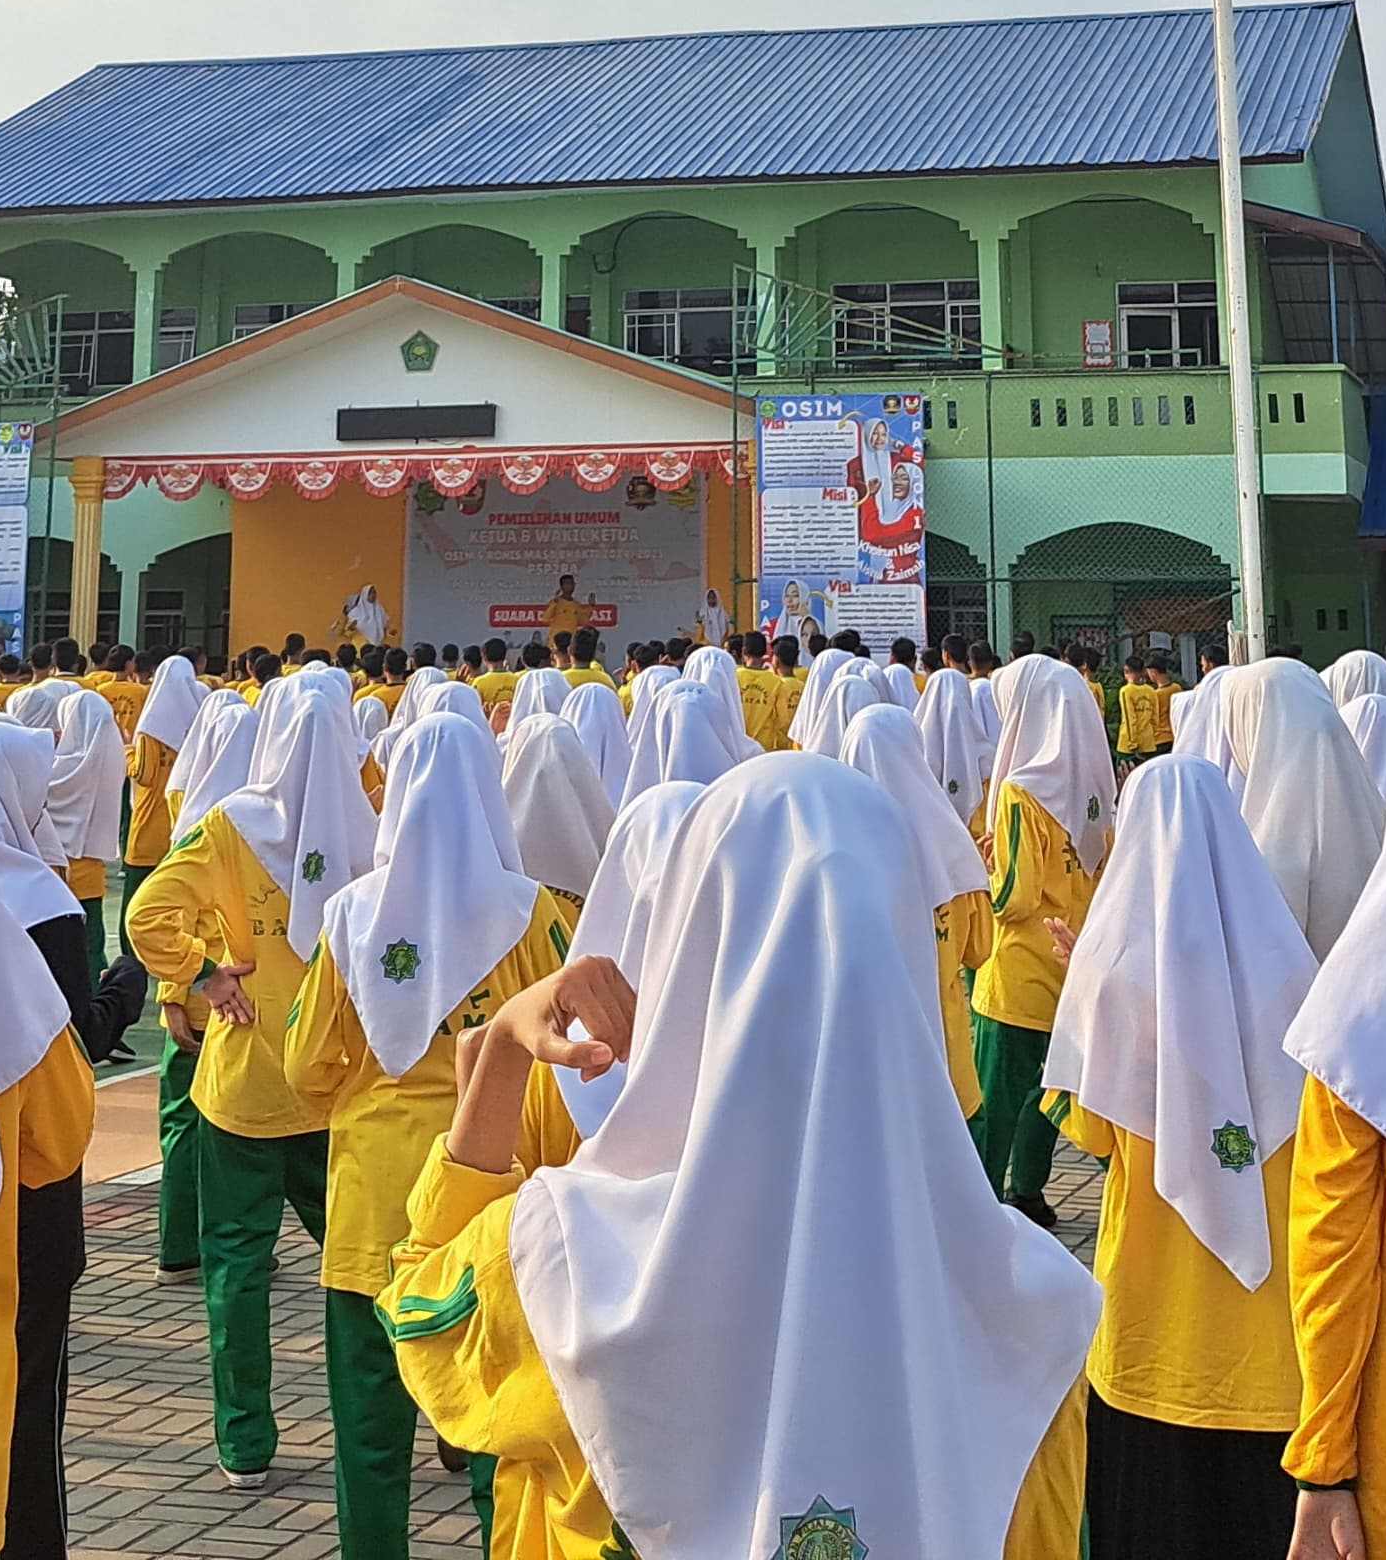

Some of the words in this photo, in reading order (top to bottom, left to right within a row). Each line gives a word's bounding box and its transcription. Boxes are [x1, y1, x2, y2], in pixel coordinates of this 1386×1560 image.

[781, 400, 843, 417] OSIM
[821, 488, 848, 501] Misi
[488, 510, 571, 526] PEMILIHAN
[574, 510, 621, 525] UMUM
[913, 515, 922, 529] 1
[468, 528, 517, 544] KETUA
[535, 528, 588, 543] WAKIL
[591, 527, 639, 542] KETUA
[827, 579, 852, 593] Visi
[493, 609, 535, 623] SUARA
